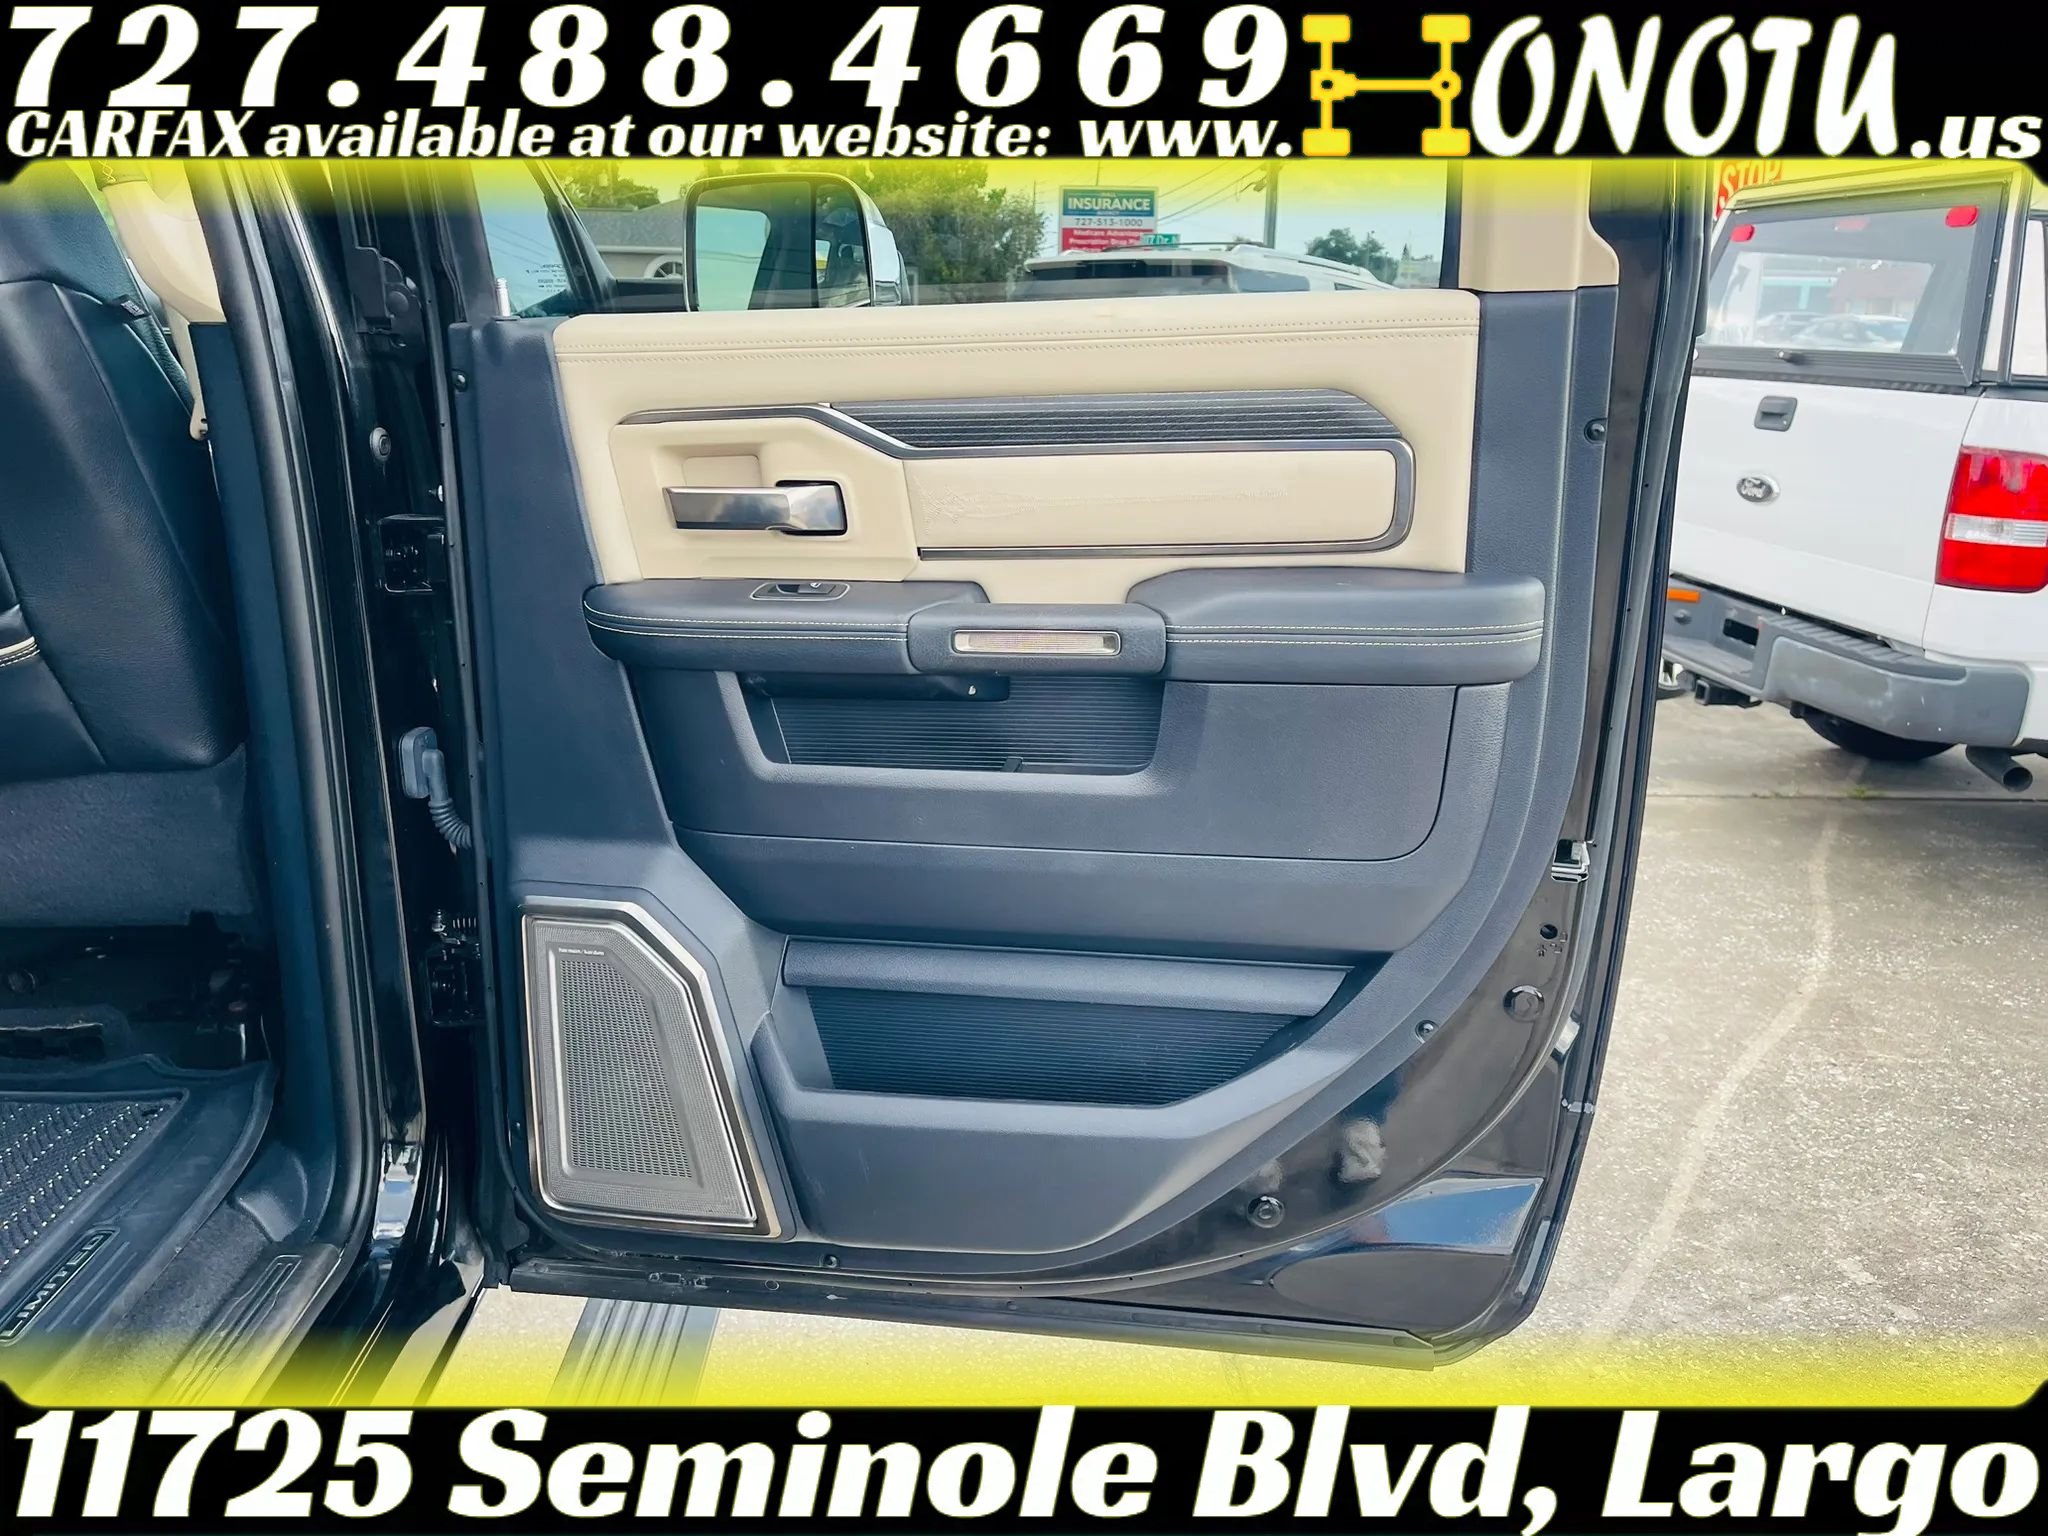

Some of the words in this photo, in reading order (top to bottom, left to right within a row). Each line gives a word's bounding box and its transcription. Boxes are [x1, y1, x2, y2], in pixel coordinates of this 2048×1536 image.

[1068, 197, 1151, 211] INSURANCE
[1074, 217, 1144, 227] 727-513-1000
[0, 1234, 105, 1337] LIMITED
